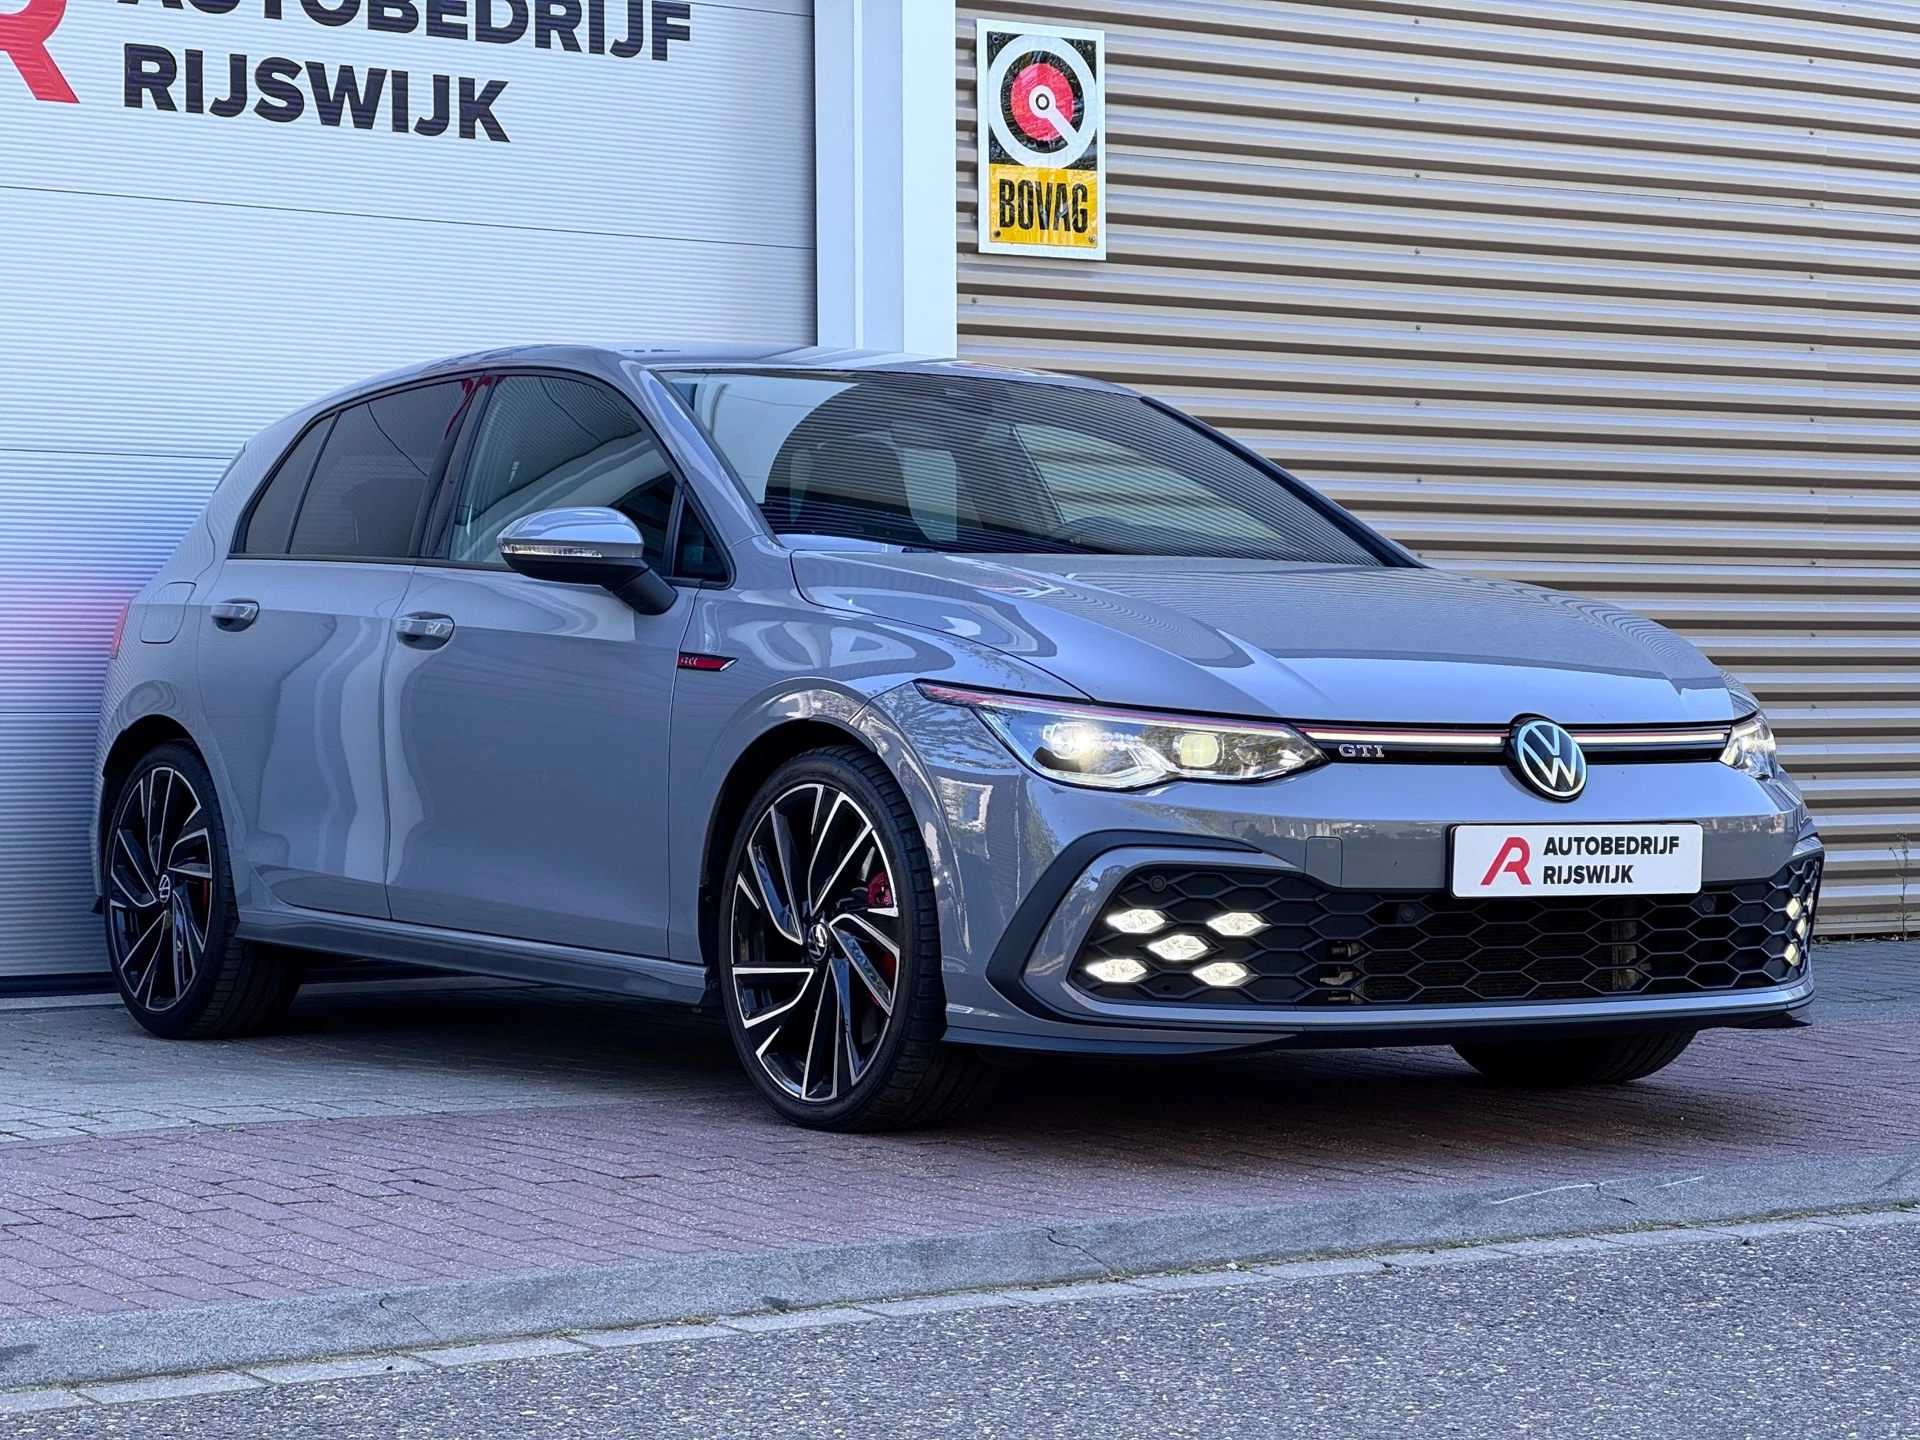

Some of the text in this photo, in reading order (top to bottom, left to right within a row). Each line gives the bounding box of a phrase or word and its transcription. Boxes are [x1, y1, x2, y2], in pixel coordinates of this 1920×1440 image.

[117, 0, 691, 61] BEDRIJF
[123, 43, 511, 143] RIJSWIJK
[999, 178, 1088, 233] BOVAG
[1338, 743, 1385, 758] GTI
[1543, 836, 1680, 856] AUTOBEDRIJF
[1543, 865, 1634, 885] RIJSWIJK
